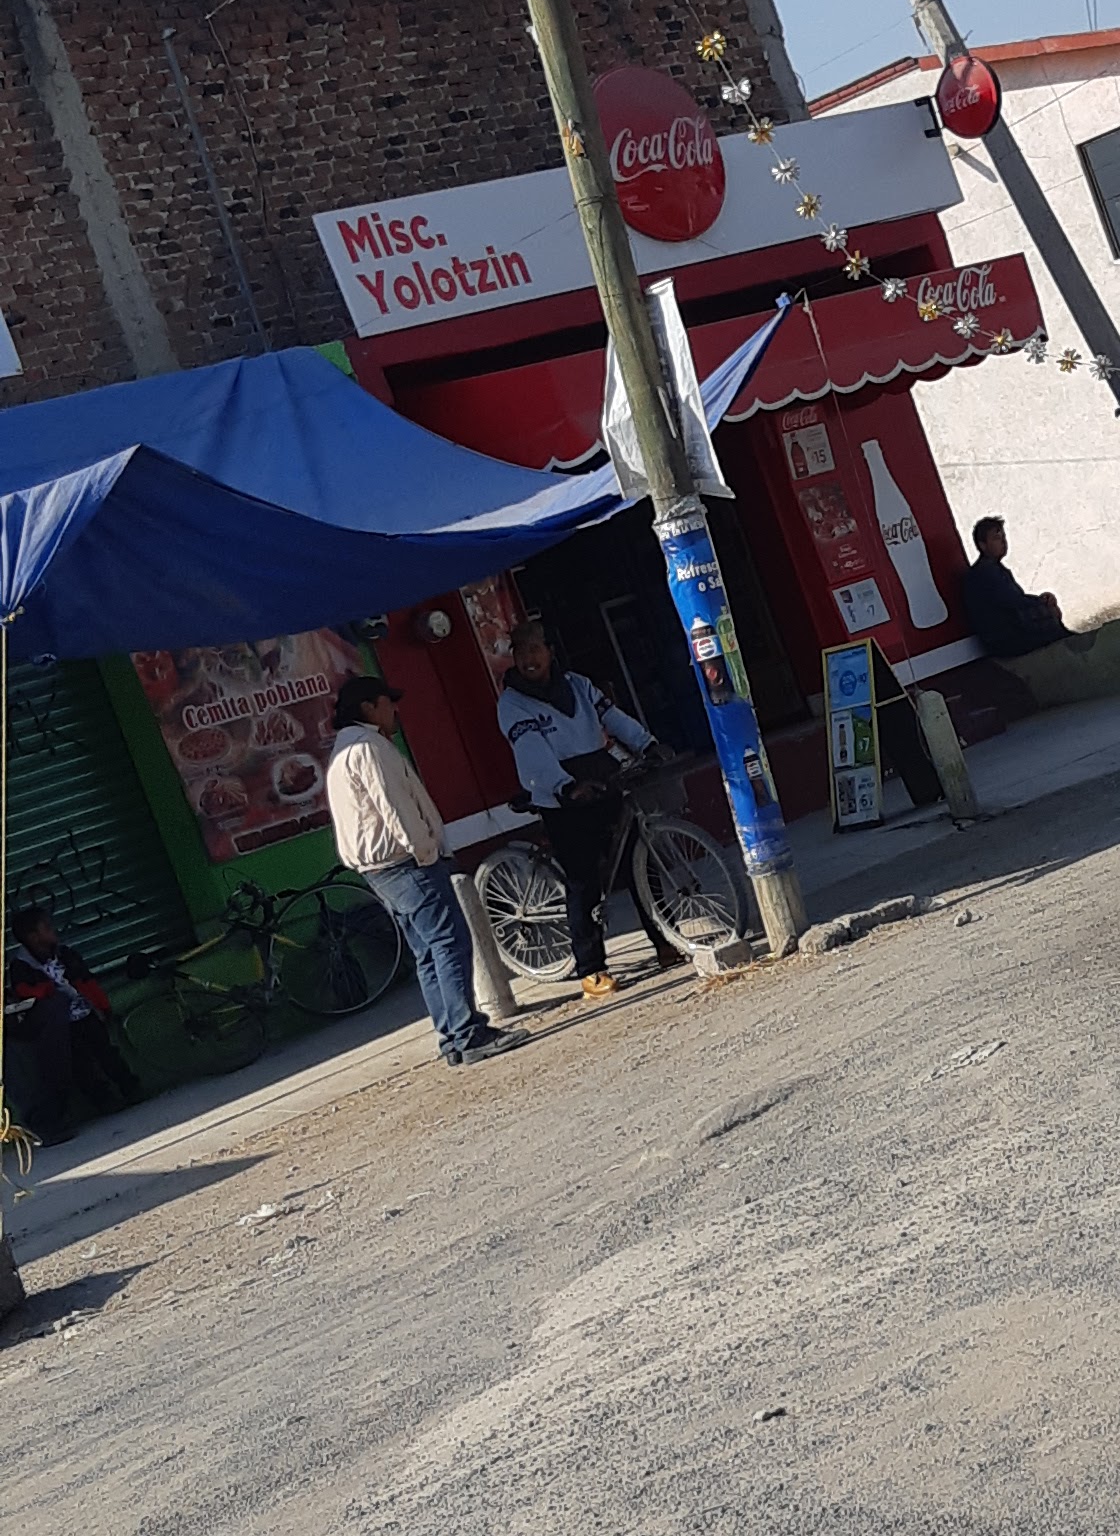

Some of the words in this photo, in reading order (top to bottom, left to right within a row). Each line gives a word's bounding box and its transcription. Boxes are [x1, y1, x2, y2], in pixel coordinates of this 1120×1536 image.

[337, 212, 448, 263] Misc.
[356, 245, 532, 314] Yolotzin
[184, 695, 250, 730] Cemita
[253, 674, 330, 715] poblana
